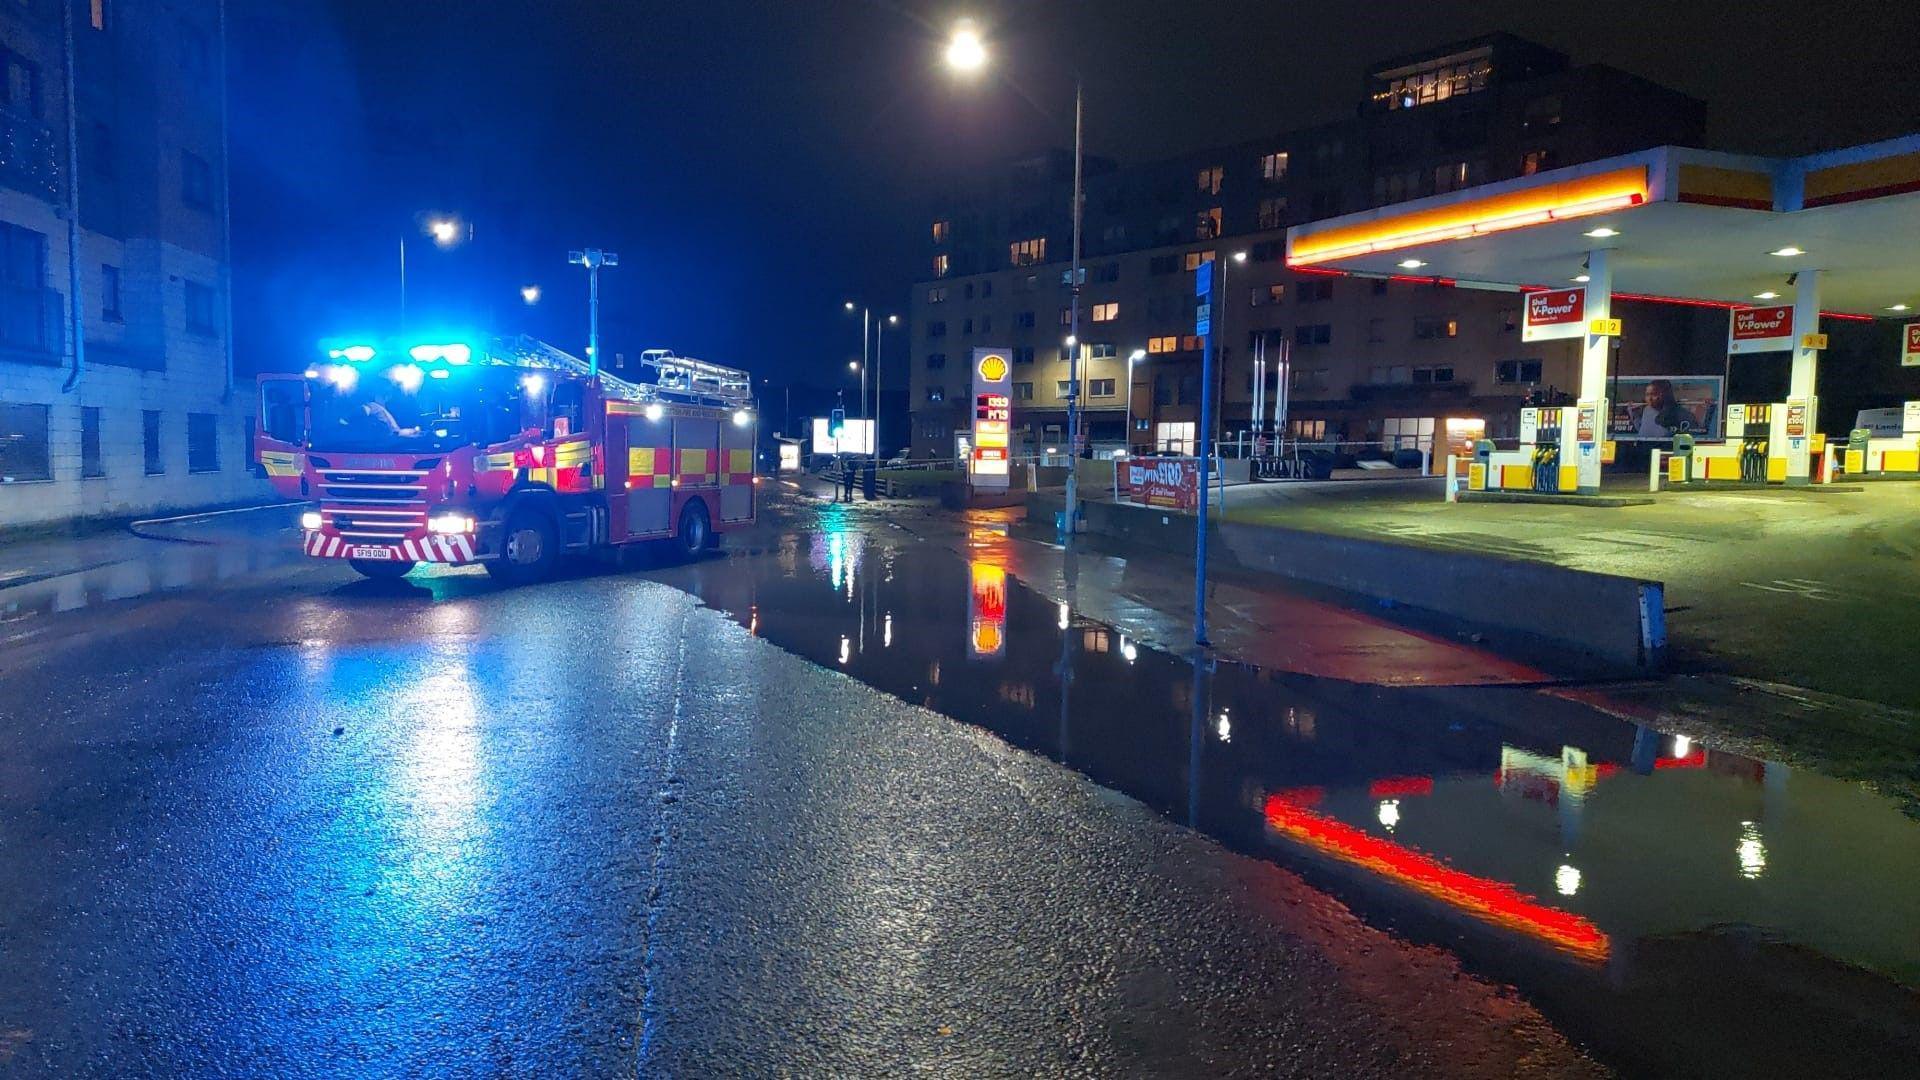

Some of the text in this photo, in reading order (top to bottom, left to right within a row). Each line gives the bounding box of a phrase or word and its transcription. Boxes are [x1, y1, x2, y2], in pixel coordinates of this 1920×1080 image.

[1532, 297, 1547, 306] Shell
[1532, 304, 1573, 316] V-Power
[1610, 322, 1616, 331] 2
[1738, 320, 1781, 330] V-Power
[1157, 462, 1181, 487] £100
